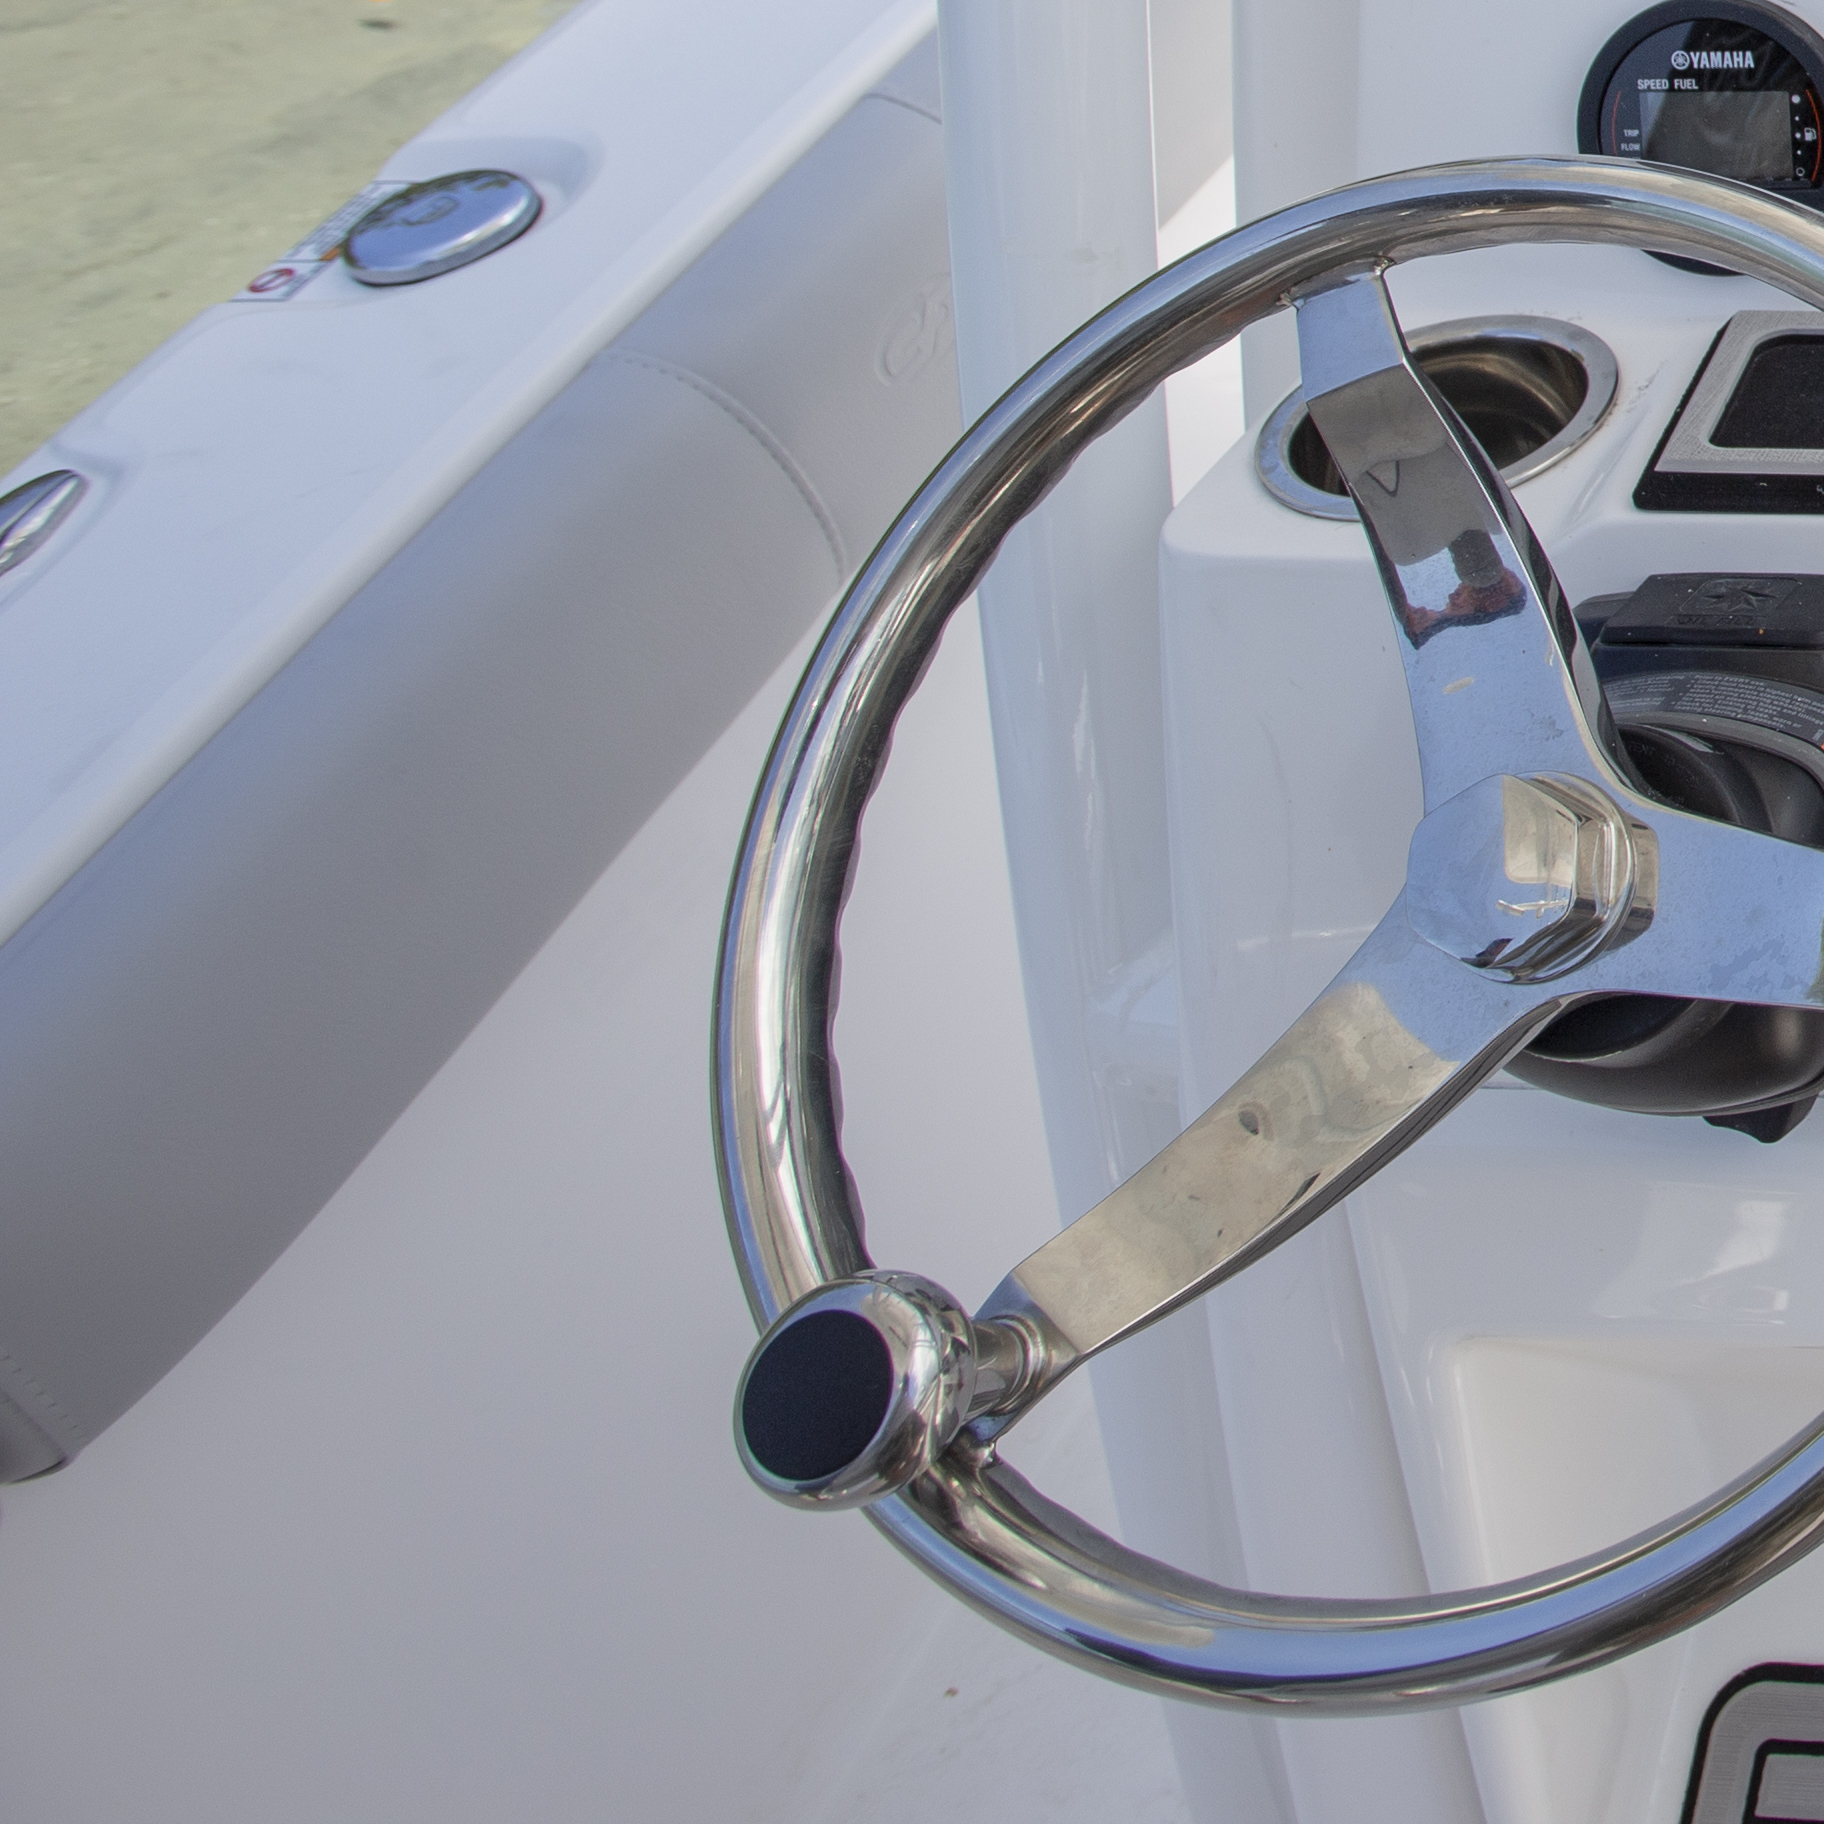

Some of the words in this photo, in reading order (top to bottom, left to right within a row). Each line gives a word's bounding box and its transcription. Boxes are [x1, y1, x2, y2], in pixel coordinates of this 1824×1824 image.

[1687, 50, 1755, 69] YAMAHA
[1636, 78, 1670, 90] SPEED
[1673, 78, 1699, 90] FUEL
[1622, 128, 1640, 137] TRIP
[1620, 142, 1640, 151] FLOW
